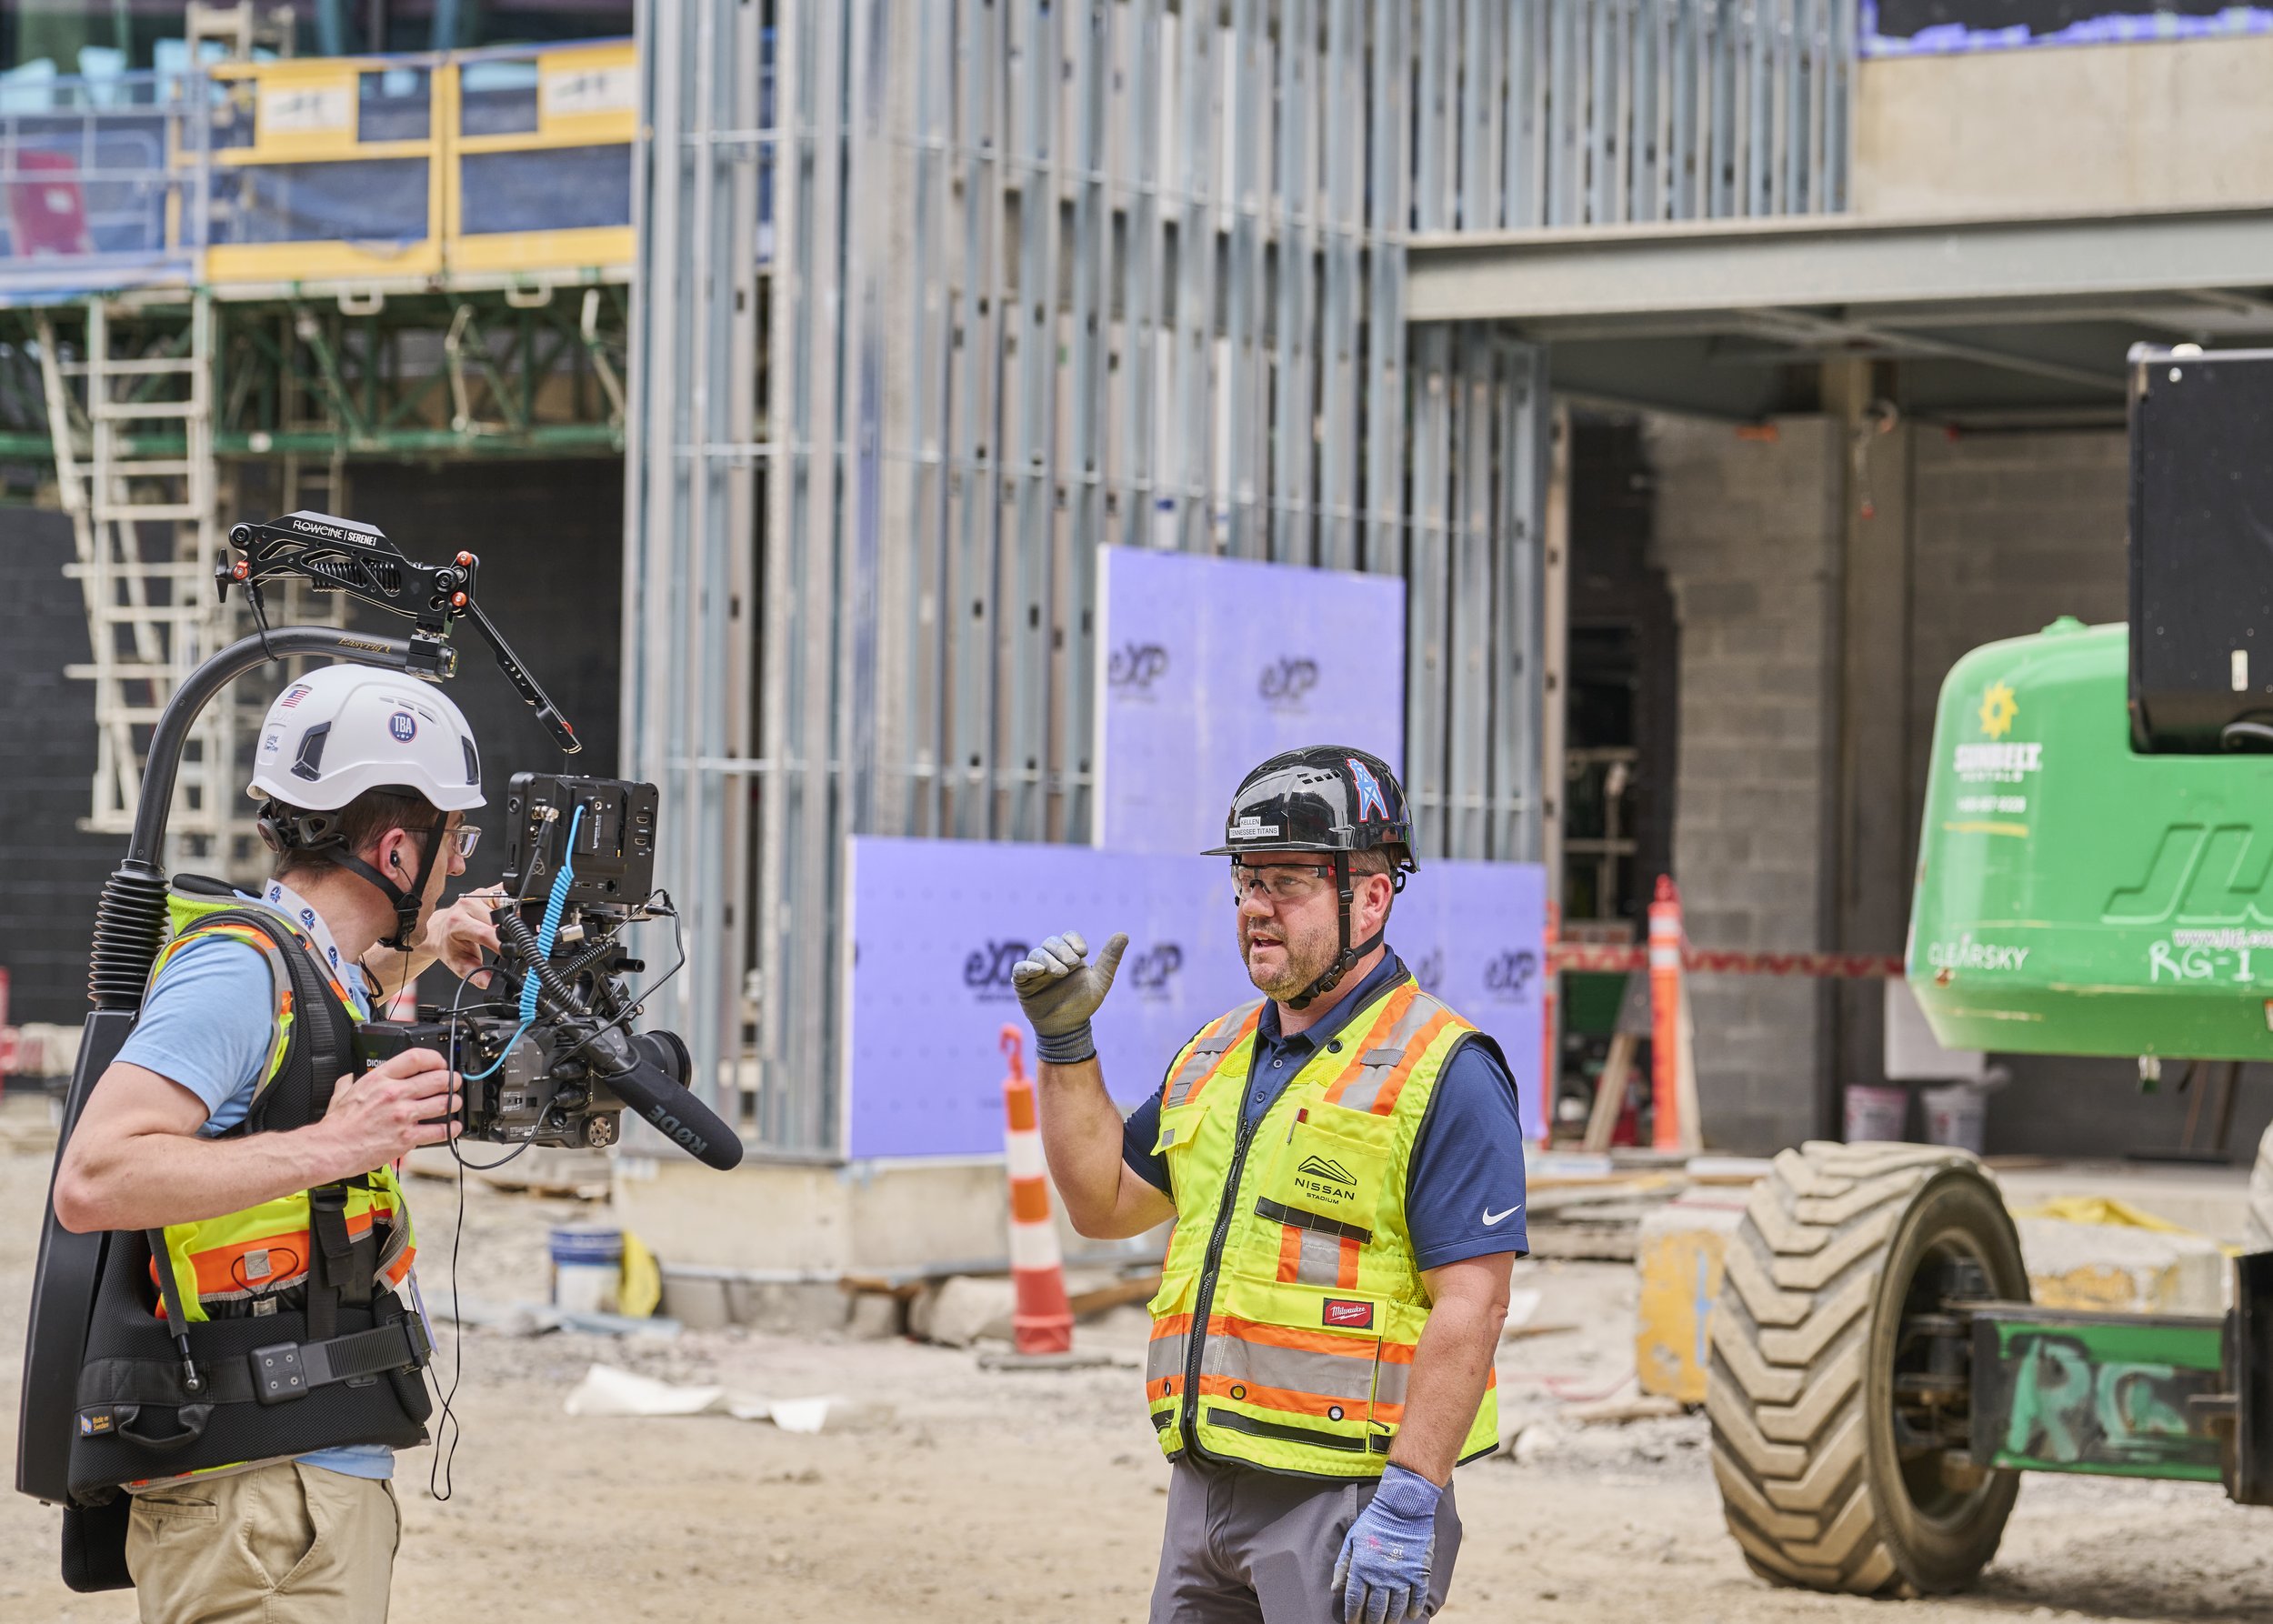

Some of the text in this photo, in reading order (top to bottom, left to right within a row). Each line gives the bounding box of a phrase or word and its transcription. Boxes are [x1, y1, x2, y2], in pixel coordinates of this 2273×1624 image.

[293, 520, 344, 539] FLOWCINE
[338, 637, 383, 653] Easyrig
[393, 715, 413, 735] TBA
[1230, 828, 1256, 837] TENNESSEE
[2101, 822, 2273, 924] JL
[647, 1105, 708, 1155] RØDE
[1295, 1178, 1355, 1200] NISSAN
[1306, 1192, 1339, 1205] STADIUM
[1330, 1306, 1367, 1317] Milwaukee
